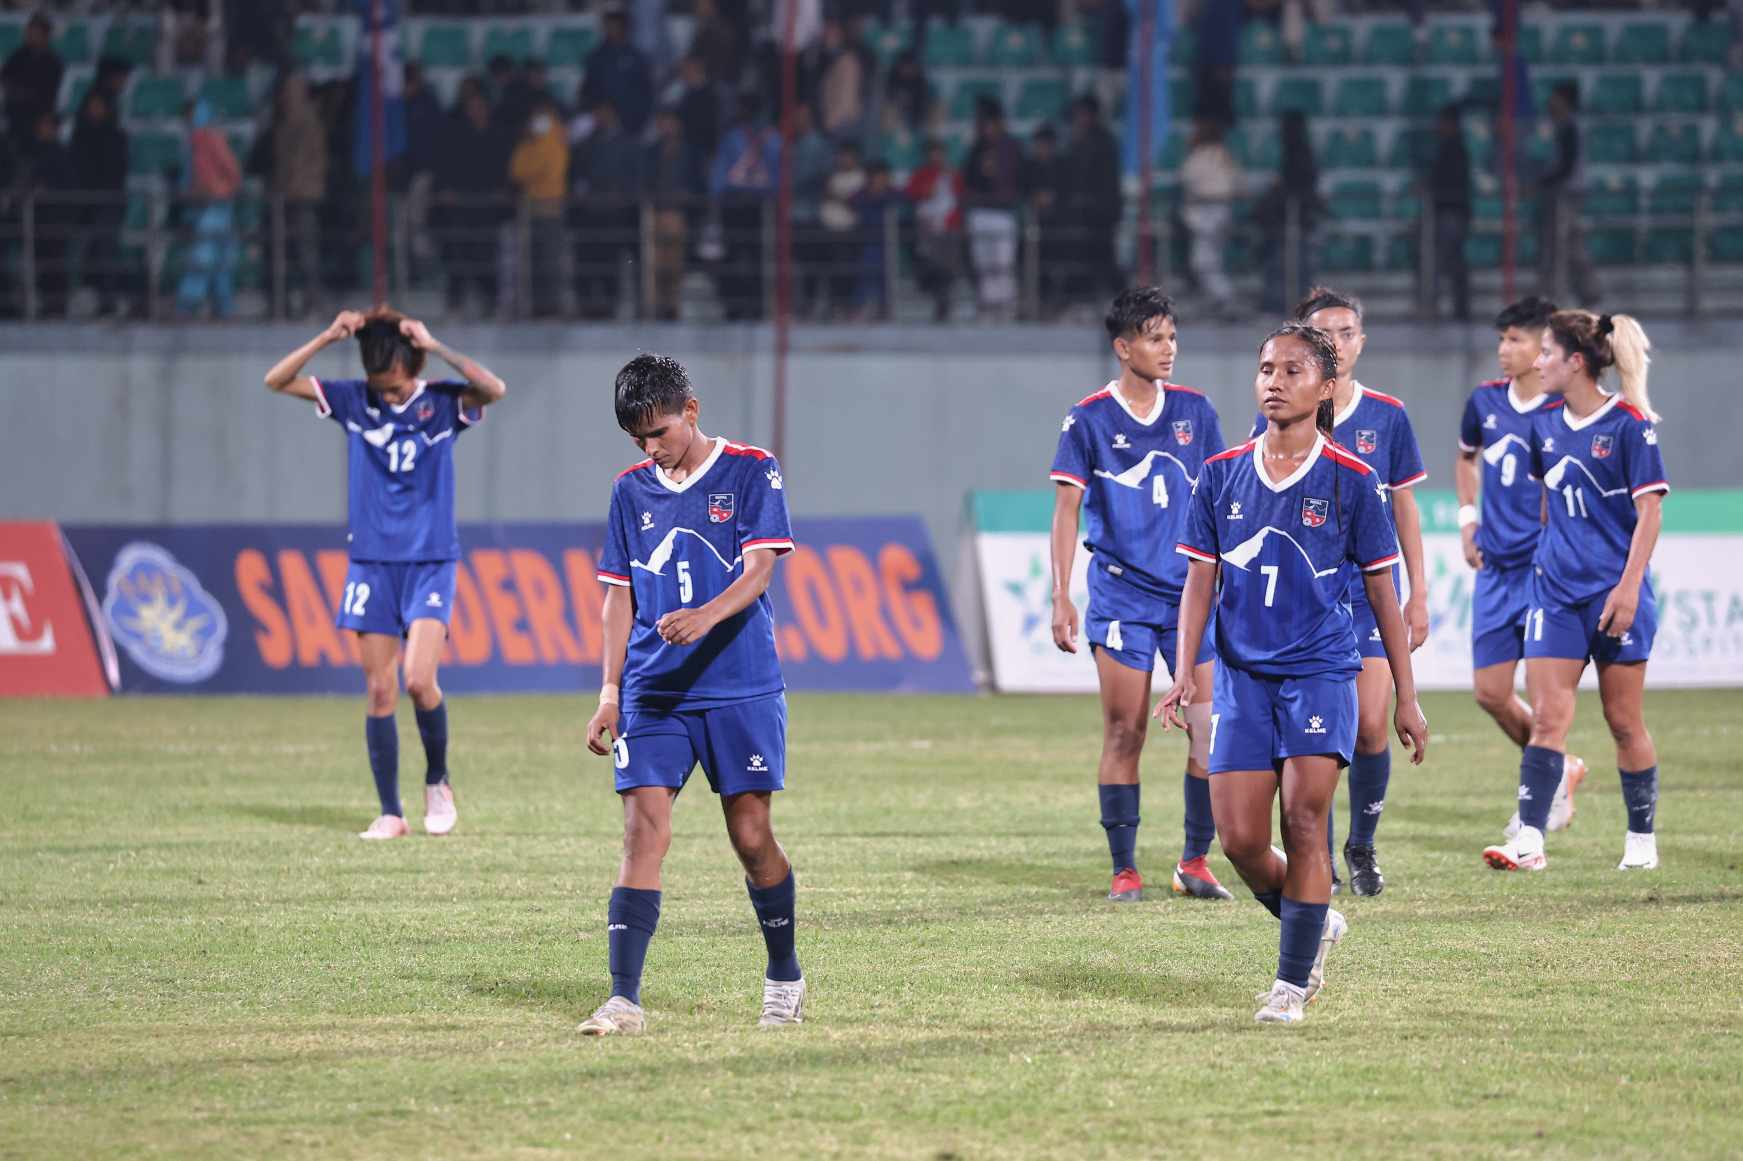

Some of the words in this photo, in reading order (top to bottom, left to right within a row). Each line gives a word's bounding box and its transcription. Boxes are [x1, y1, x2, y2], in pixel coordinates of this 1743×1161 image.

[387, 440, 417, 472] 12
[1501, 453, 1517, 487] 9
[1153, 474, 1169, 509] 4
[1562, 484, 1588, 518] 11
[344, 581, 370, 616] 12
[677, 560, 693, 603] 5
[1260, 565, 1279, 607] 7
[1106, 620, 1123, 651] 4
[1304, 726, 1327, 734] KELME
